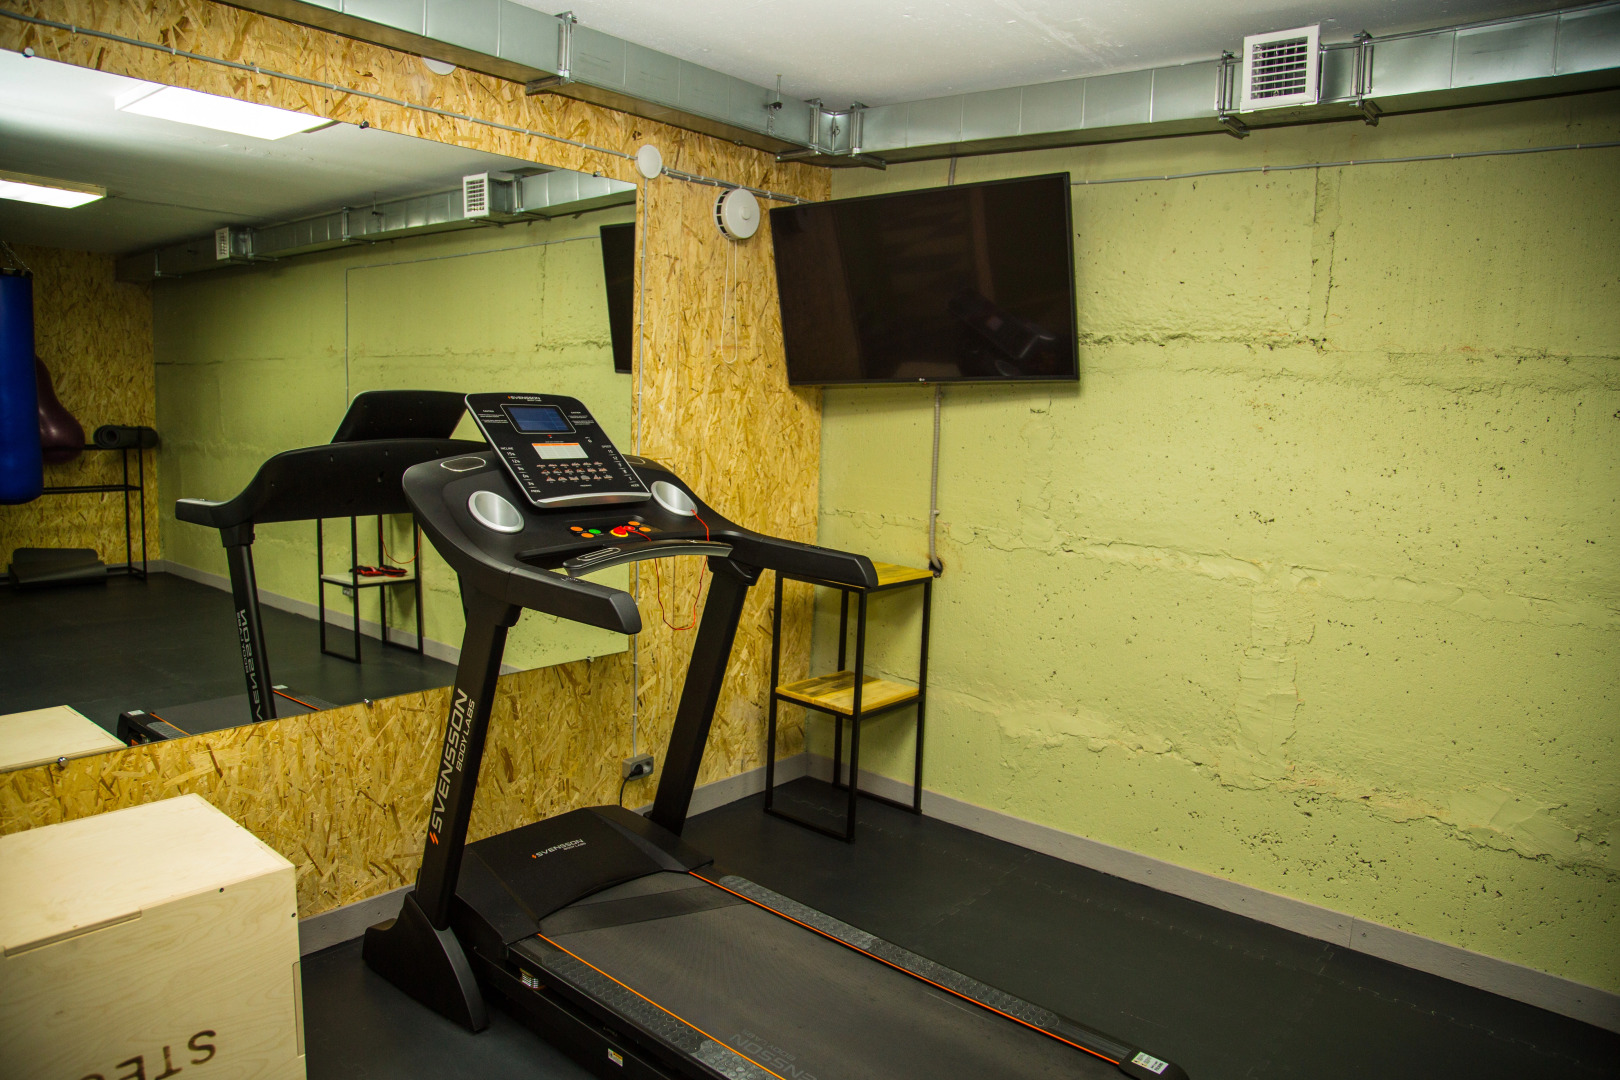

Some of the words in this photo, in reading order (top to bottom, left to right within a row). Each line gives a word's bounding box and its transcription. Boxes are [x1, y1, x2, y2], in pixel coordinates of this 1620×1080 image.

[431, 688, 468, 834] SVENSSON
[455, 735, 468, 772] BODY
[463, 698, 476, 736] LABS
[535, 838, 584, 858] SVENSSON
[78, 1029, 217, 1080] STE
